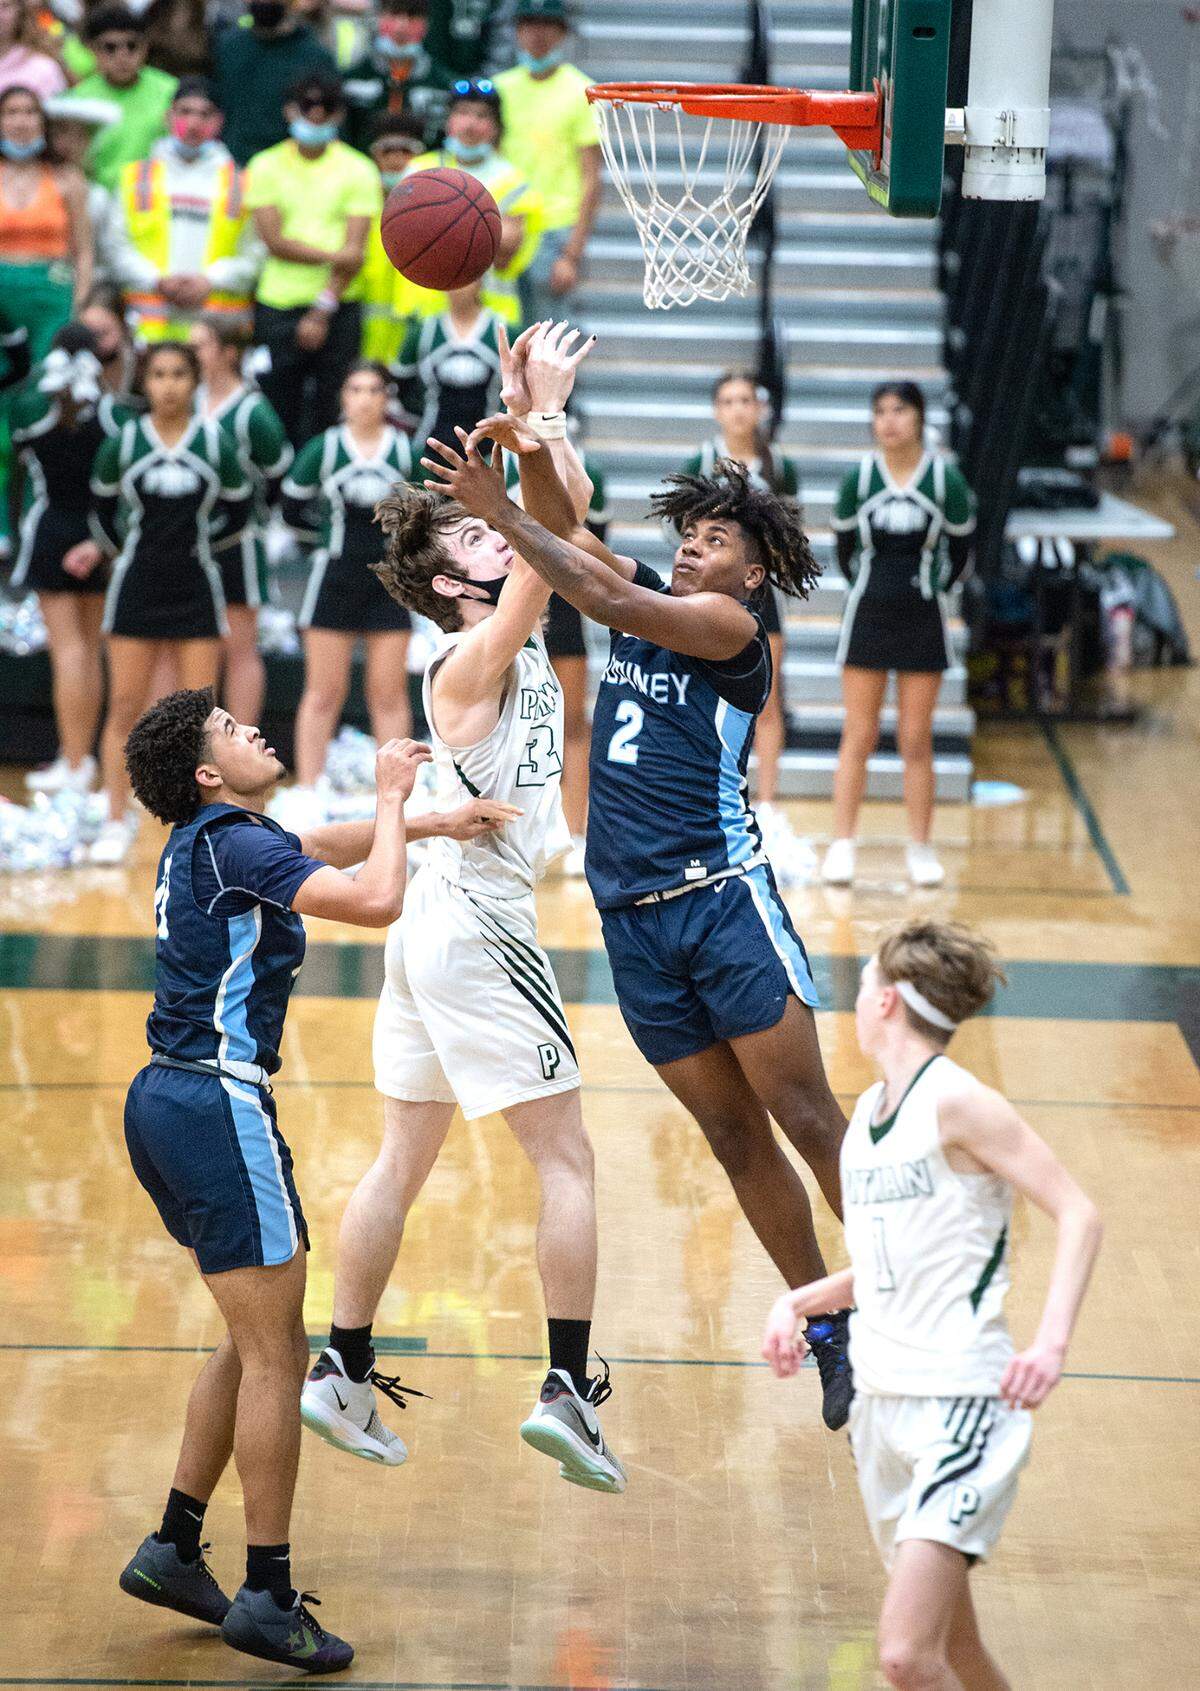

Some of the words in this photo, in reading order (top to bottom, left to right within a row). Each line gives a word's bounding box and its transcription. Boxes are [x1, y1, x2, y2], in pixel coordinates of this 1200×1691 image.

[607, 700, 645, 766] 2
[537, 1042, 560, 1080] P
[872, 1217, 896, 1291] 1
[950, 1484, 980, 1525] P
